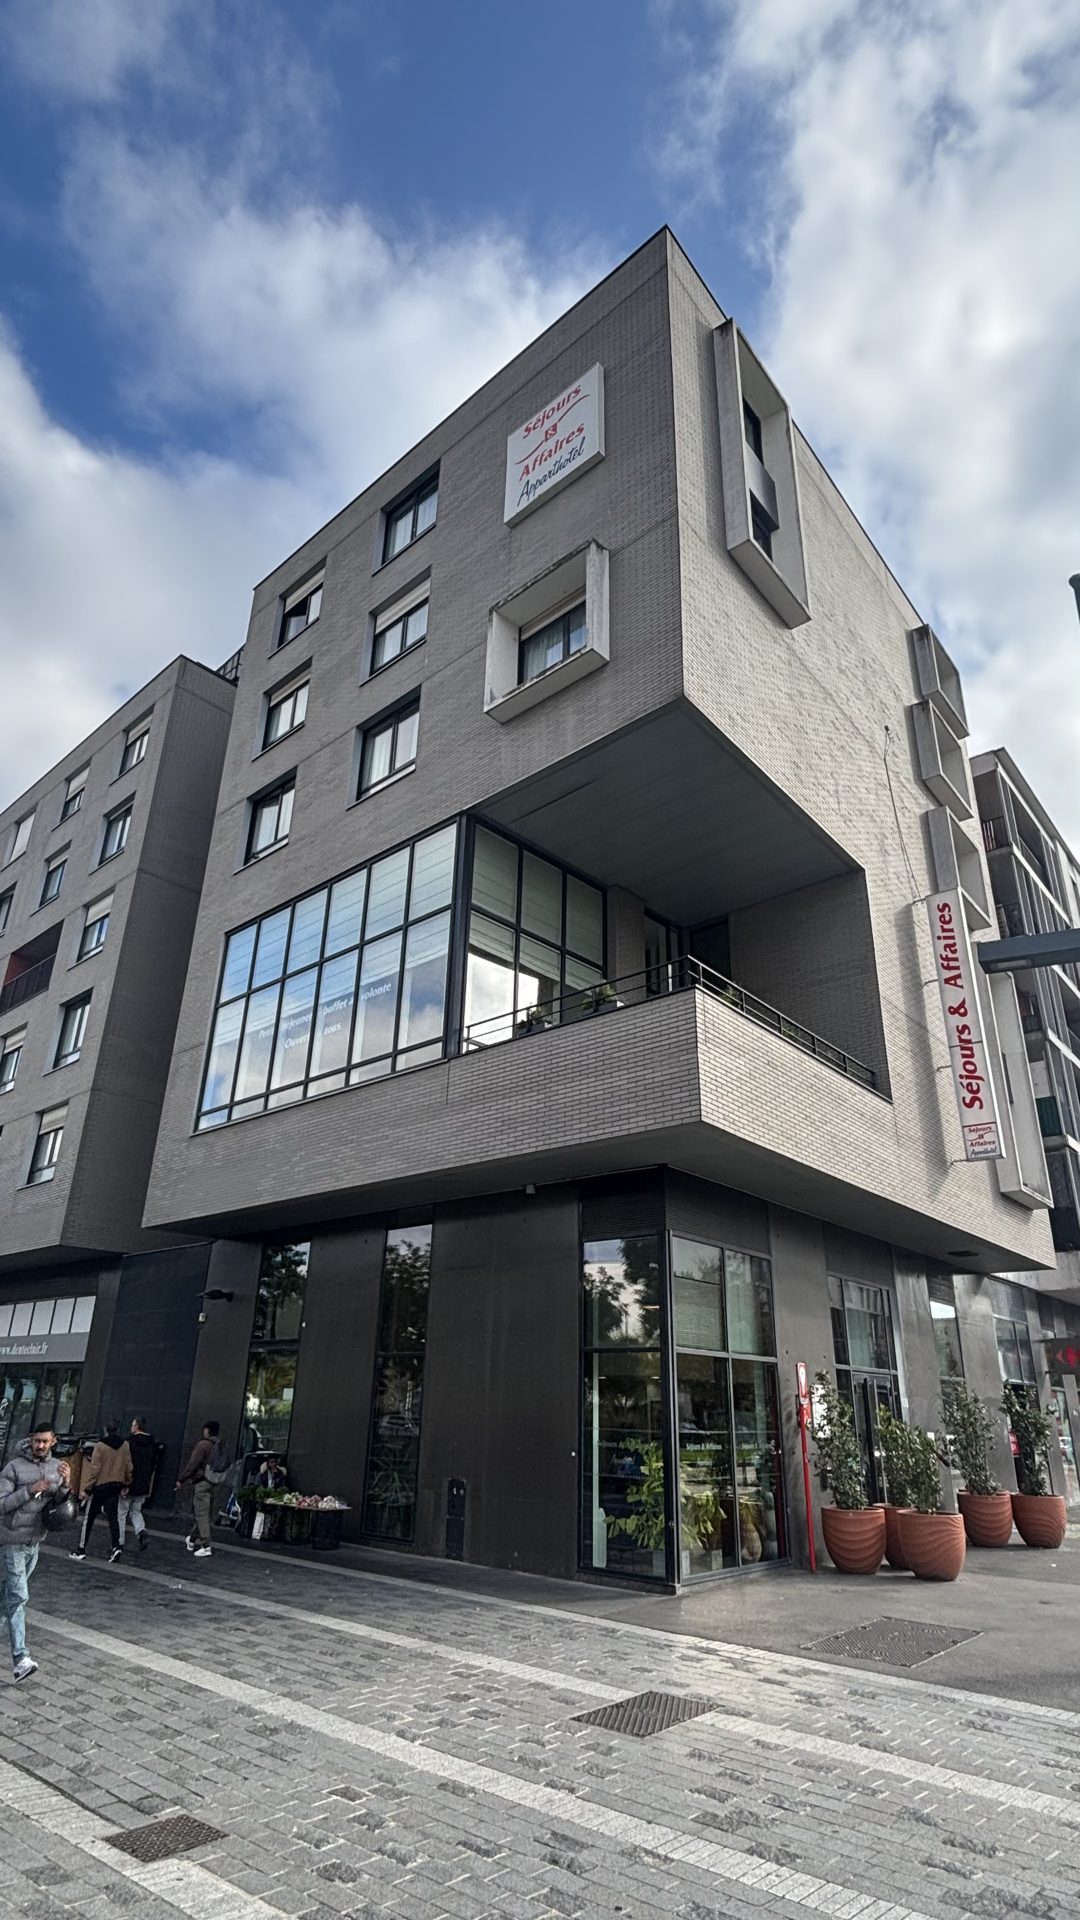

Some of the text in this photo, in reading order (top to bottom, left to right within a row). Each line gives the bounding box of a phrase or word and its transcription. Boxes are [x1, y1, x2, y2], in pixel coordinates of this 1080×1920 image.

[523, 385, 582, 439] Séjours
[517, 436, 586, 507] Apparthotel
[519, 422, 585, 482] Affaires
[937, 902, 985, 1110] Séjours & Affaires
